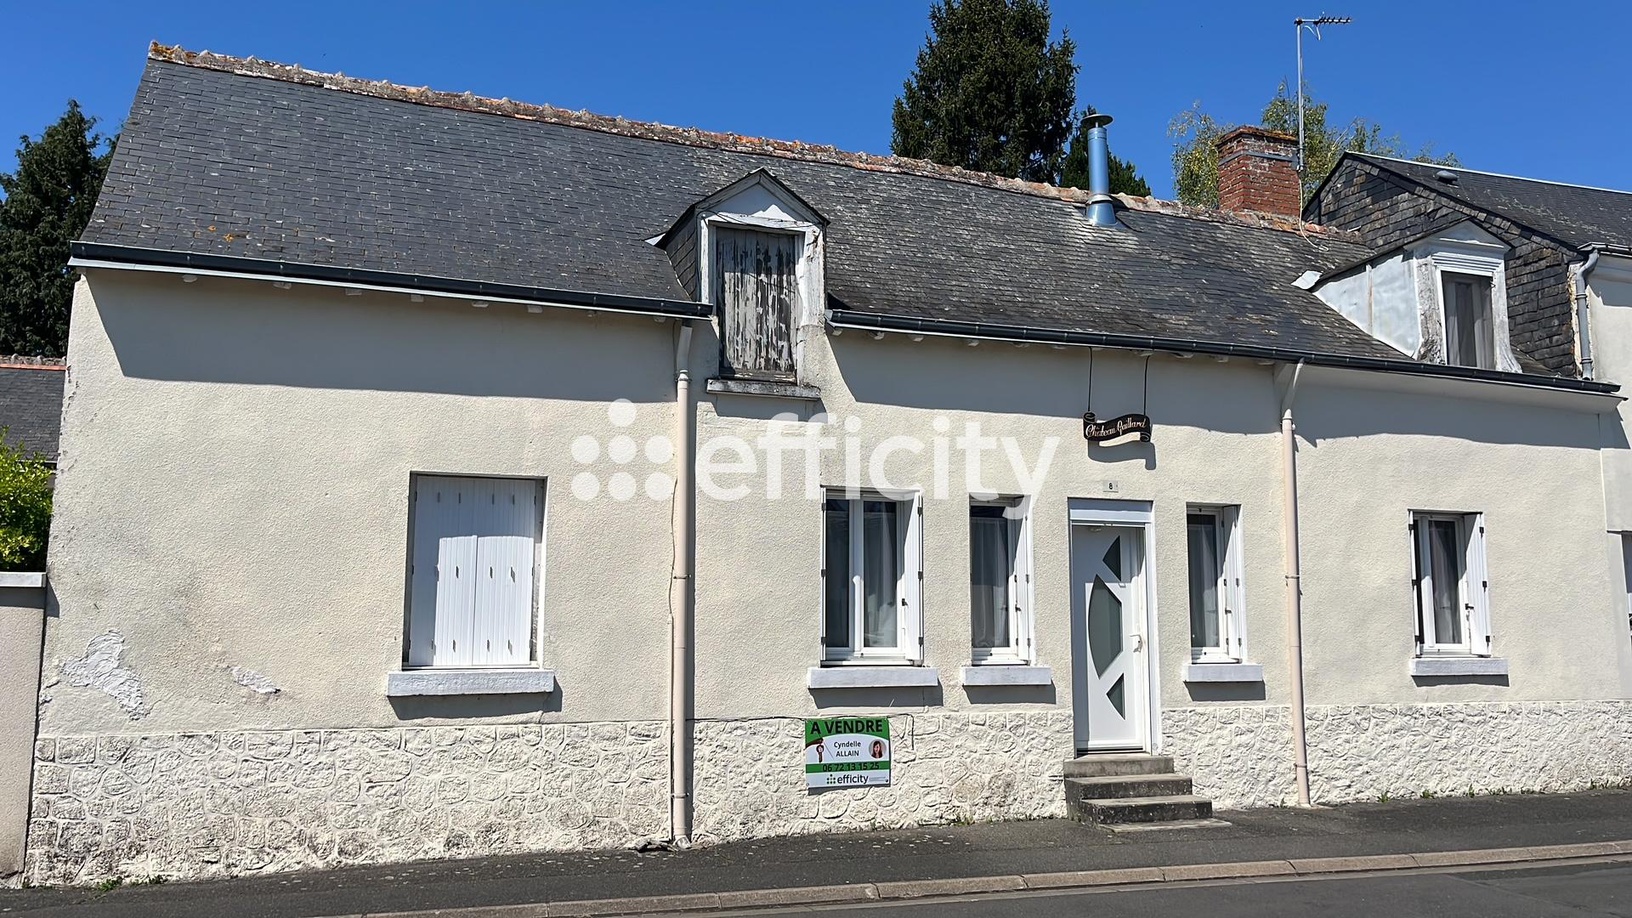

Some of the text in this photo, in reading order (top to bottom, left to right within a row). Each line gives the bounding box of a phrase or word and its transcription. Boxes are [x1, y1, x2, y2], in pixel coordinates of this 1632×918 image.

[811, 720, 882, 734] A VENDRE
[834, 741, 861, 749] Cyndelle
[822, 761, 880, 772] 06 72 13 15 25
[837, 774, 869, 784] efficity
